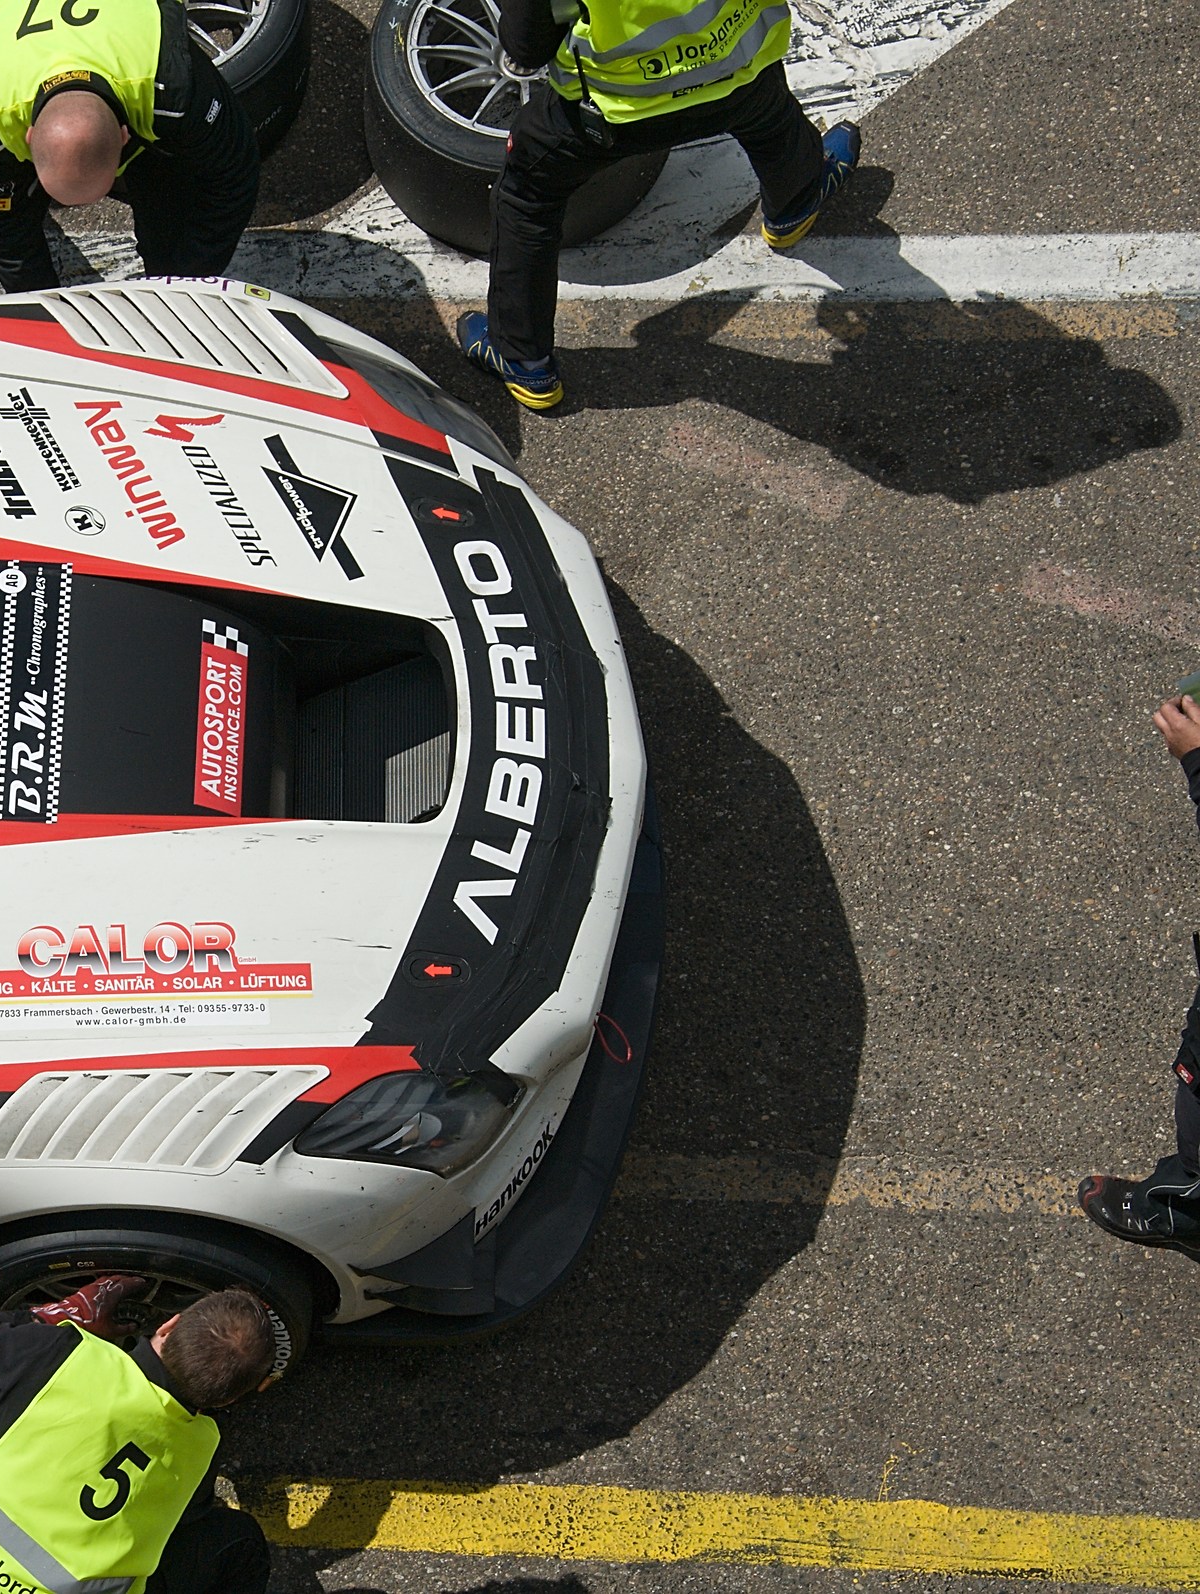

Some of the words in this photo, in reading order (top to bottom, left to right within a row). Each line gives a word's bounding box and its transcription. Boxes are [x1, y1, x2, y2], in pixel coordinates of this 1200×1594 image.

[718, 2, 760, 53] promotion
[74, 401, 187, 551] winway
[181, 446, 278, 568] SPECIALIZED
[278, 475, 325, 550] truckpower
[5, 573, 19, 588] A6
[200, 655, 229, 798] AUTOSPORT
[223, 664, 243, 802] INSURANCE.COM
[453, 539, 546, 945] ALBERTO
[17, 921, 236, 978] CALOR
[30, 978, 77, 994] KÄLTE
[94, 974, 155, 992] SANITÄR
[172, 976, 223, 990] SOLAR
[239, 972, 307, 989] LÜFTUNG
[23, 1006, 94, 1018] Frammersbach
[101, 1005, 158, 1017] Gewerbestr.
[159, 1005, 171, 1015] 14
[178, 1004, 196, 1014] Tel:
[197, 1003, 266, 1014] 09355-9733-0
[75, 1015, 187, 1027] www.calor-gmbh.de
[79, 1440, 152, 1522] 5
